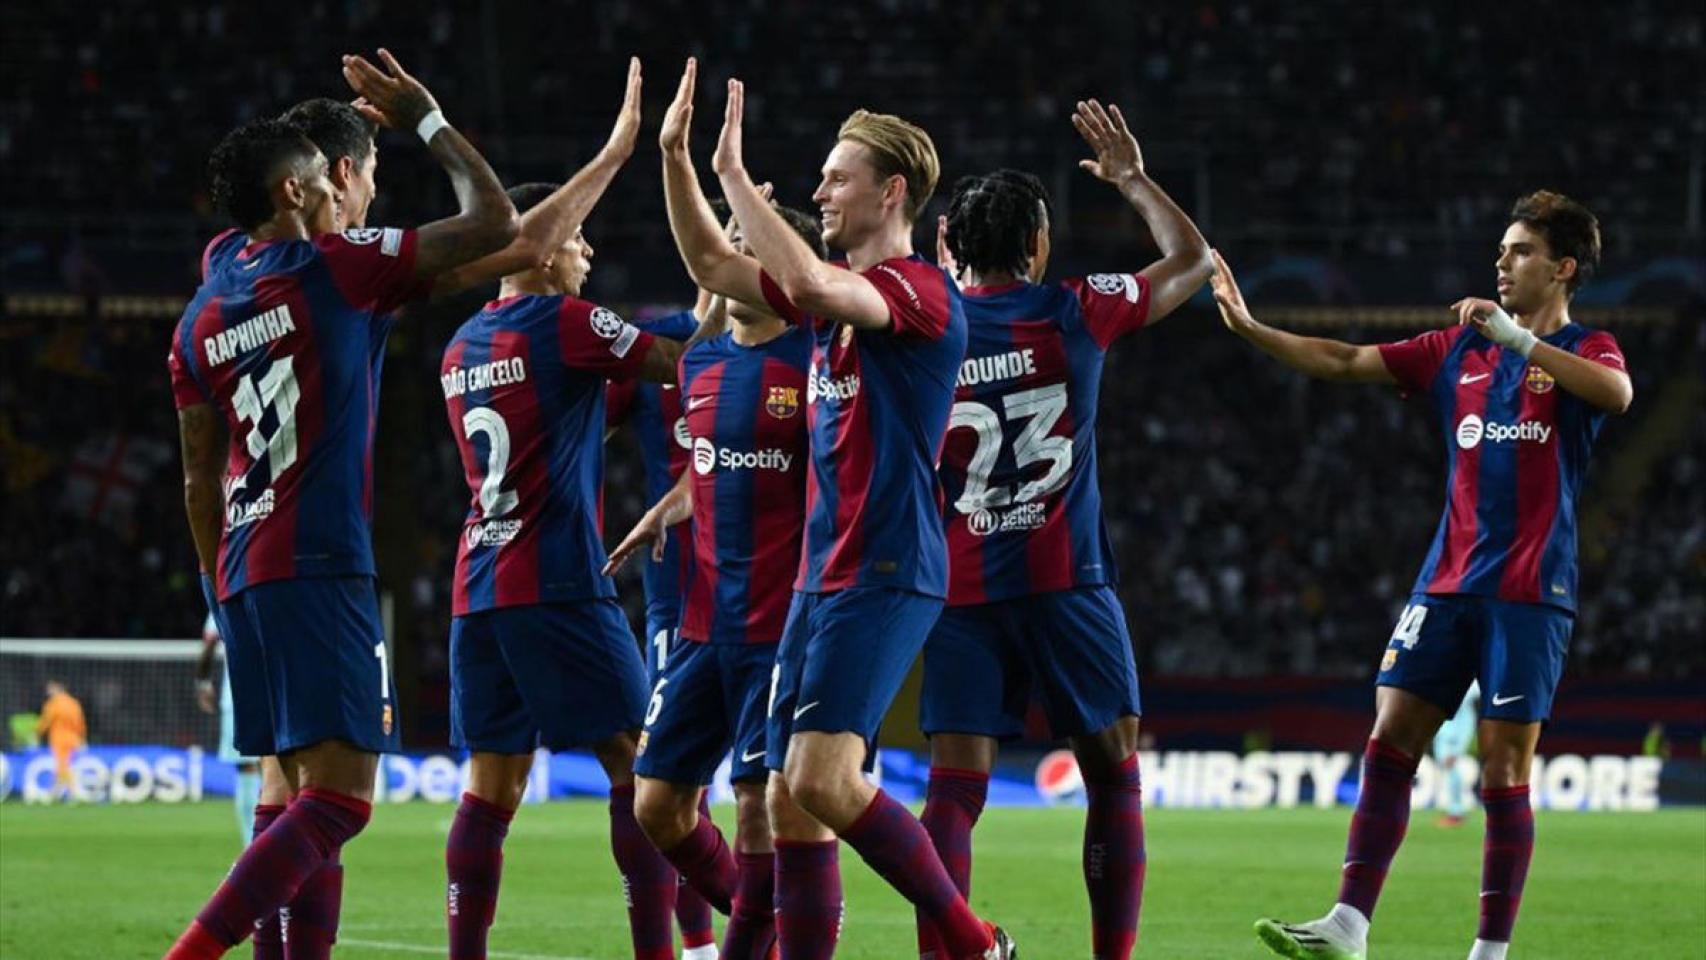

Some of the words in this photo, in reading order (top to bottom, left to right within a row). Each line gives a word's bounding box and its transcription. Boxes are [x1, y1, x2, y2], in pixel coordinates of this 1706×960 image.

[204, 303, 296, 367] RAPHINHA
[441, 366, 466, 399] OÃO
[231, 354, 301, 487] 11
[1485, 420, 1552, 444] Spotify
[462, 406, 520, 519] 2
[719, 447, 793, 472] Spotify
[948, 383, 1073, 515] 23
[644, 677, 669, 727] 6
[374, 747, 551, 803] pei
[1138, 752, 1352, 809] HIRSTY
